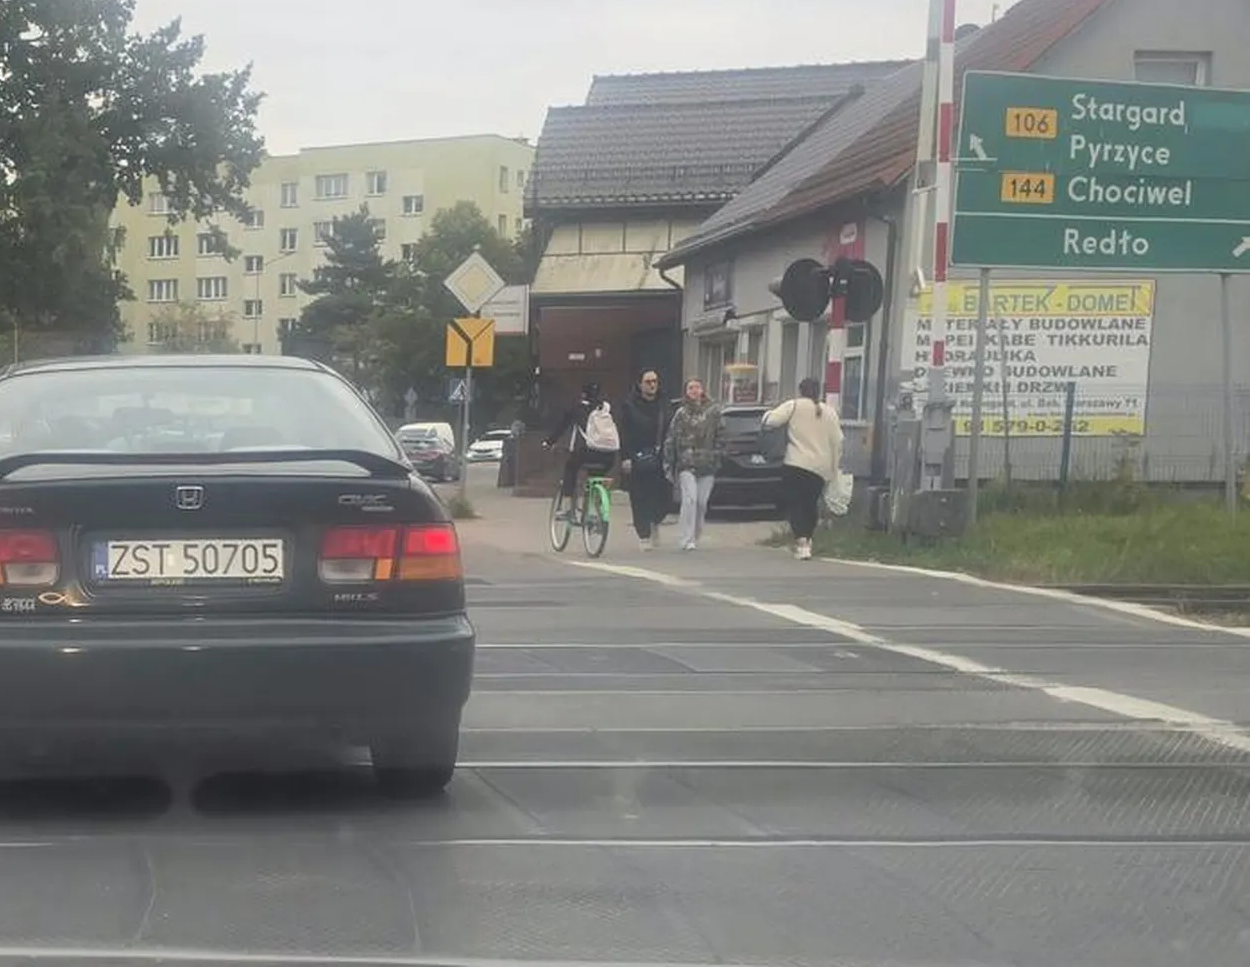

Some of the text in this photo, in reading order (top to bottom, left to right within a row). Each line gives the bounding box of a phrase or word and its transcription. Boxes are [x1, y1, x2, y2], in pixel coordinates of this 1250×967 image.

[1014, 113, 1049, 133] 106
[1070, 134, 1170, 170] Pyrzyce
[1011, 176, 1192, 205] 144 Chociwel
[1063, 228, 1149, 255] Redło
[964, 293, 1050, 312] BRTEK
[916, 318, 1147, 331] MTERAŁY BUDOWLANE
[916, 334, 975, 347] MPEI
[1047, 334, 1149, 347] TIKKURILA
[1017, 381, 1074, 393] DRZW
[111, 544, 170, 575] ZST
[183, 544, 278, 575] 50705
